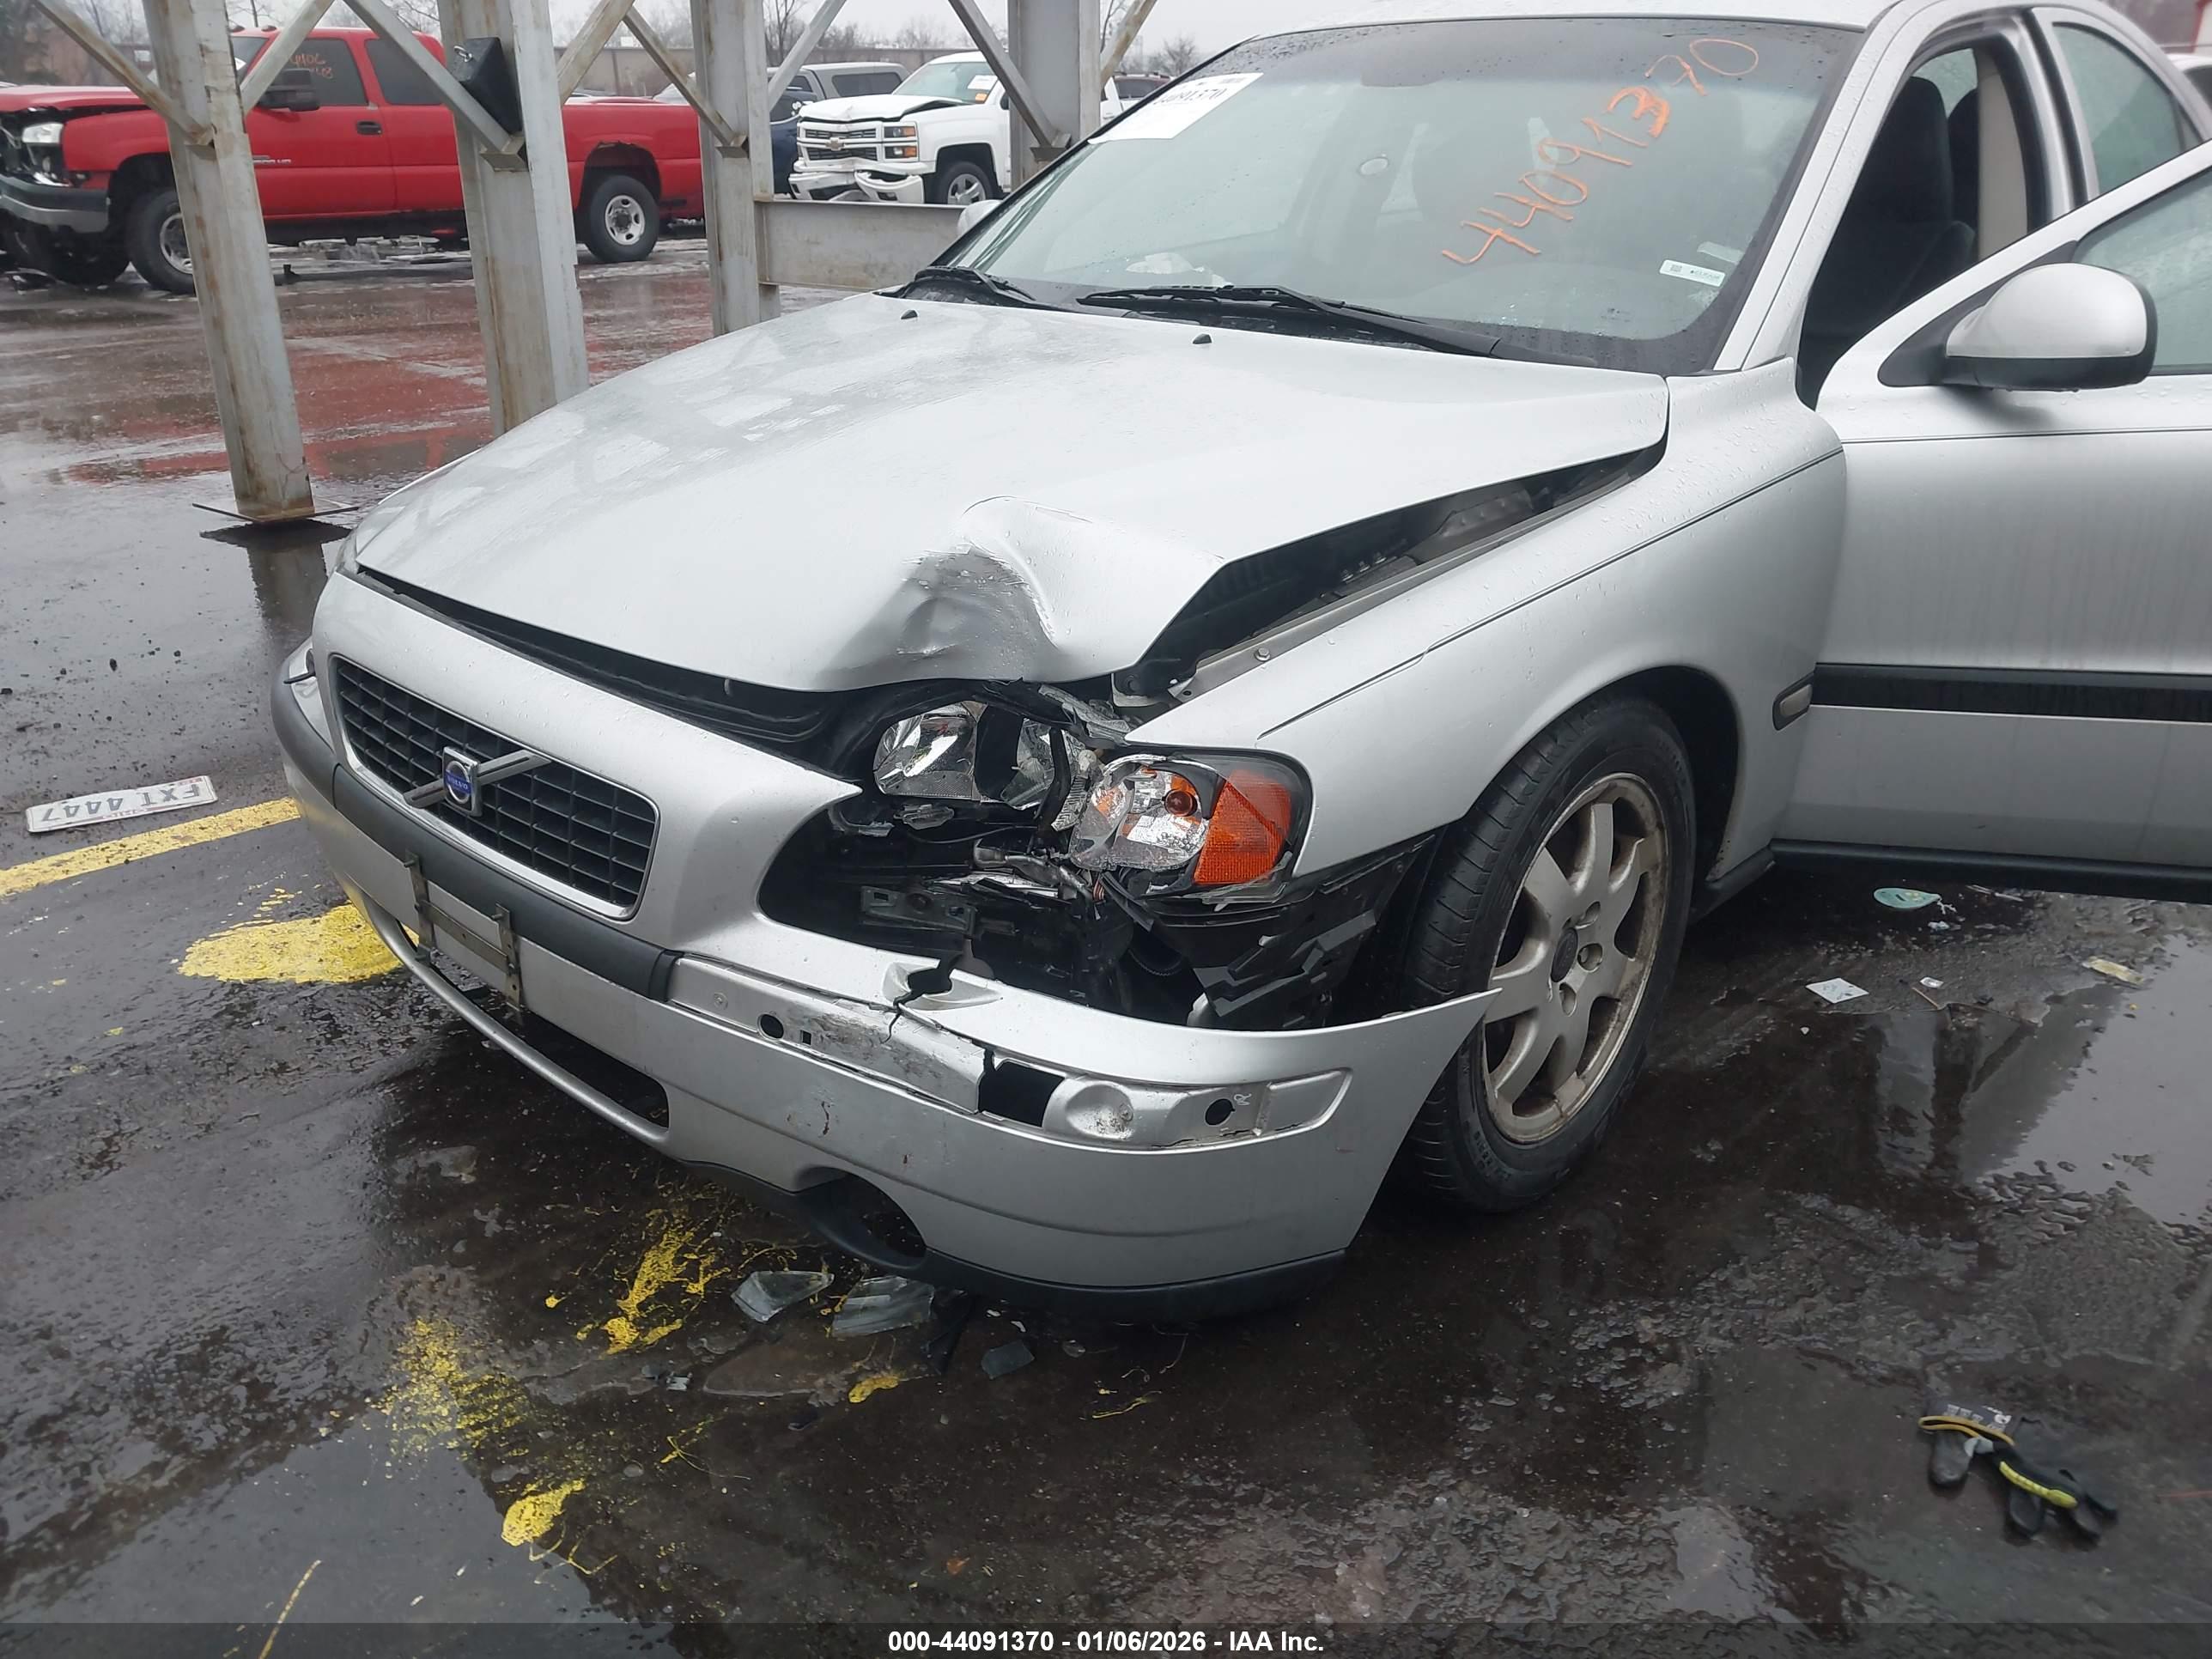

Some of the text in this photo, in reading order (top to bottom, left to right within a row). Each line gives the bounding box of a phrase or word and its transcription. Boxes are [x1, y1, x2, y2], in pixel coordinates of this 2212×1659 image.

[1442, 38, 1759, 264] 44091370
[447, 775, 469, 790] VOLVO
[40, 797, 124, 822] 4447
